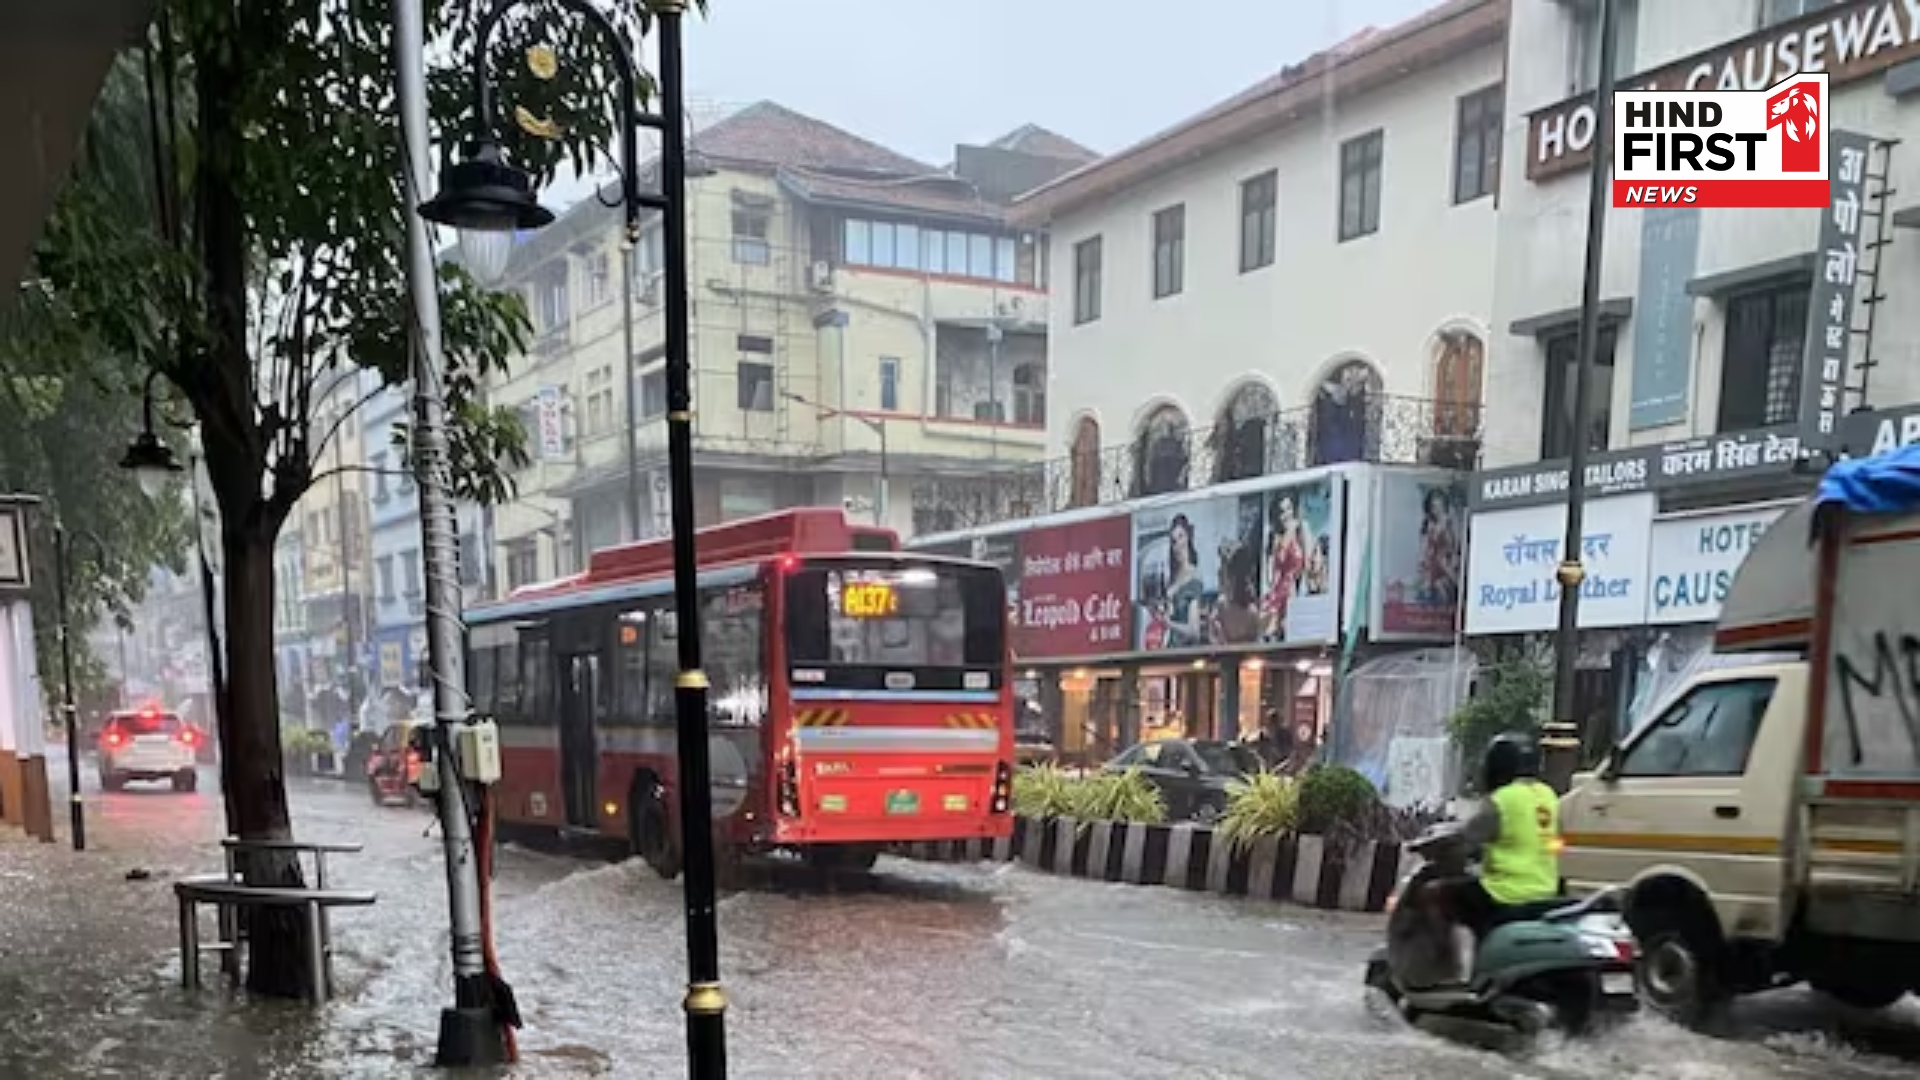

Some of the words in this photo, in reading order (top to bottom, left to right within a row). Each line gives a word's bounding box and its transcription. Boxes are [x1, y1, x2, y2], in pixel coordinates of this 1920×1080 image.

[1482, 474, 1531, 501] KARAM
[1534, 469, 1570, 493] SING
[1699, 521, 1762, 554] HOTE
[1480, 579, 1537, 610] Royal
[1544, 575, 1631, 601] Lther
[1655, 569, 1730, 607] CAUS
